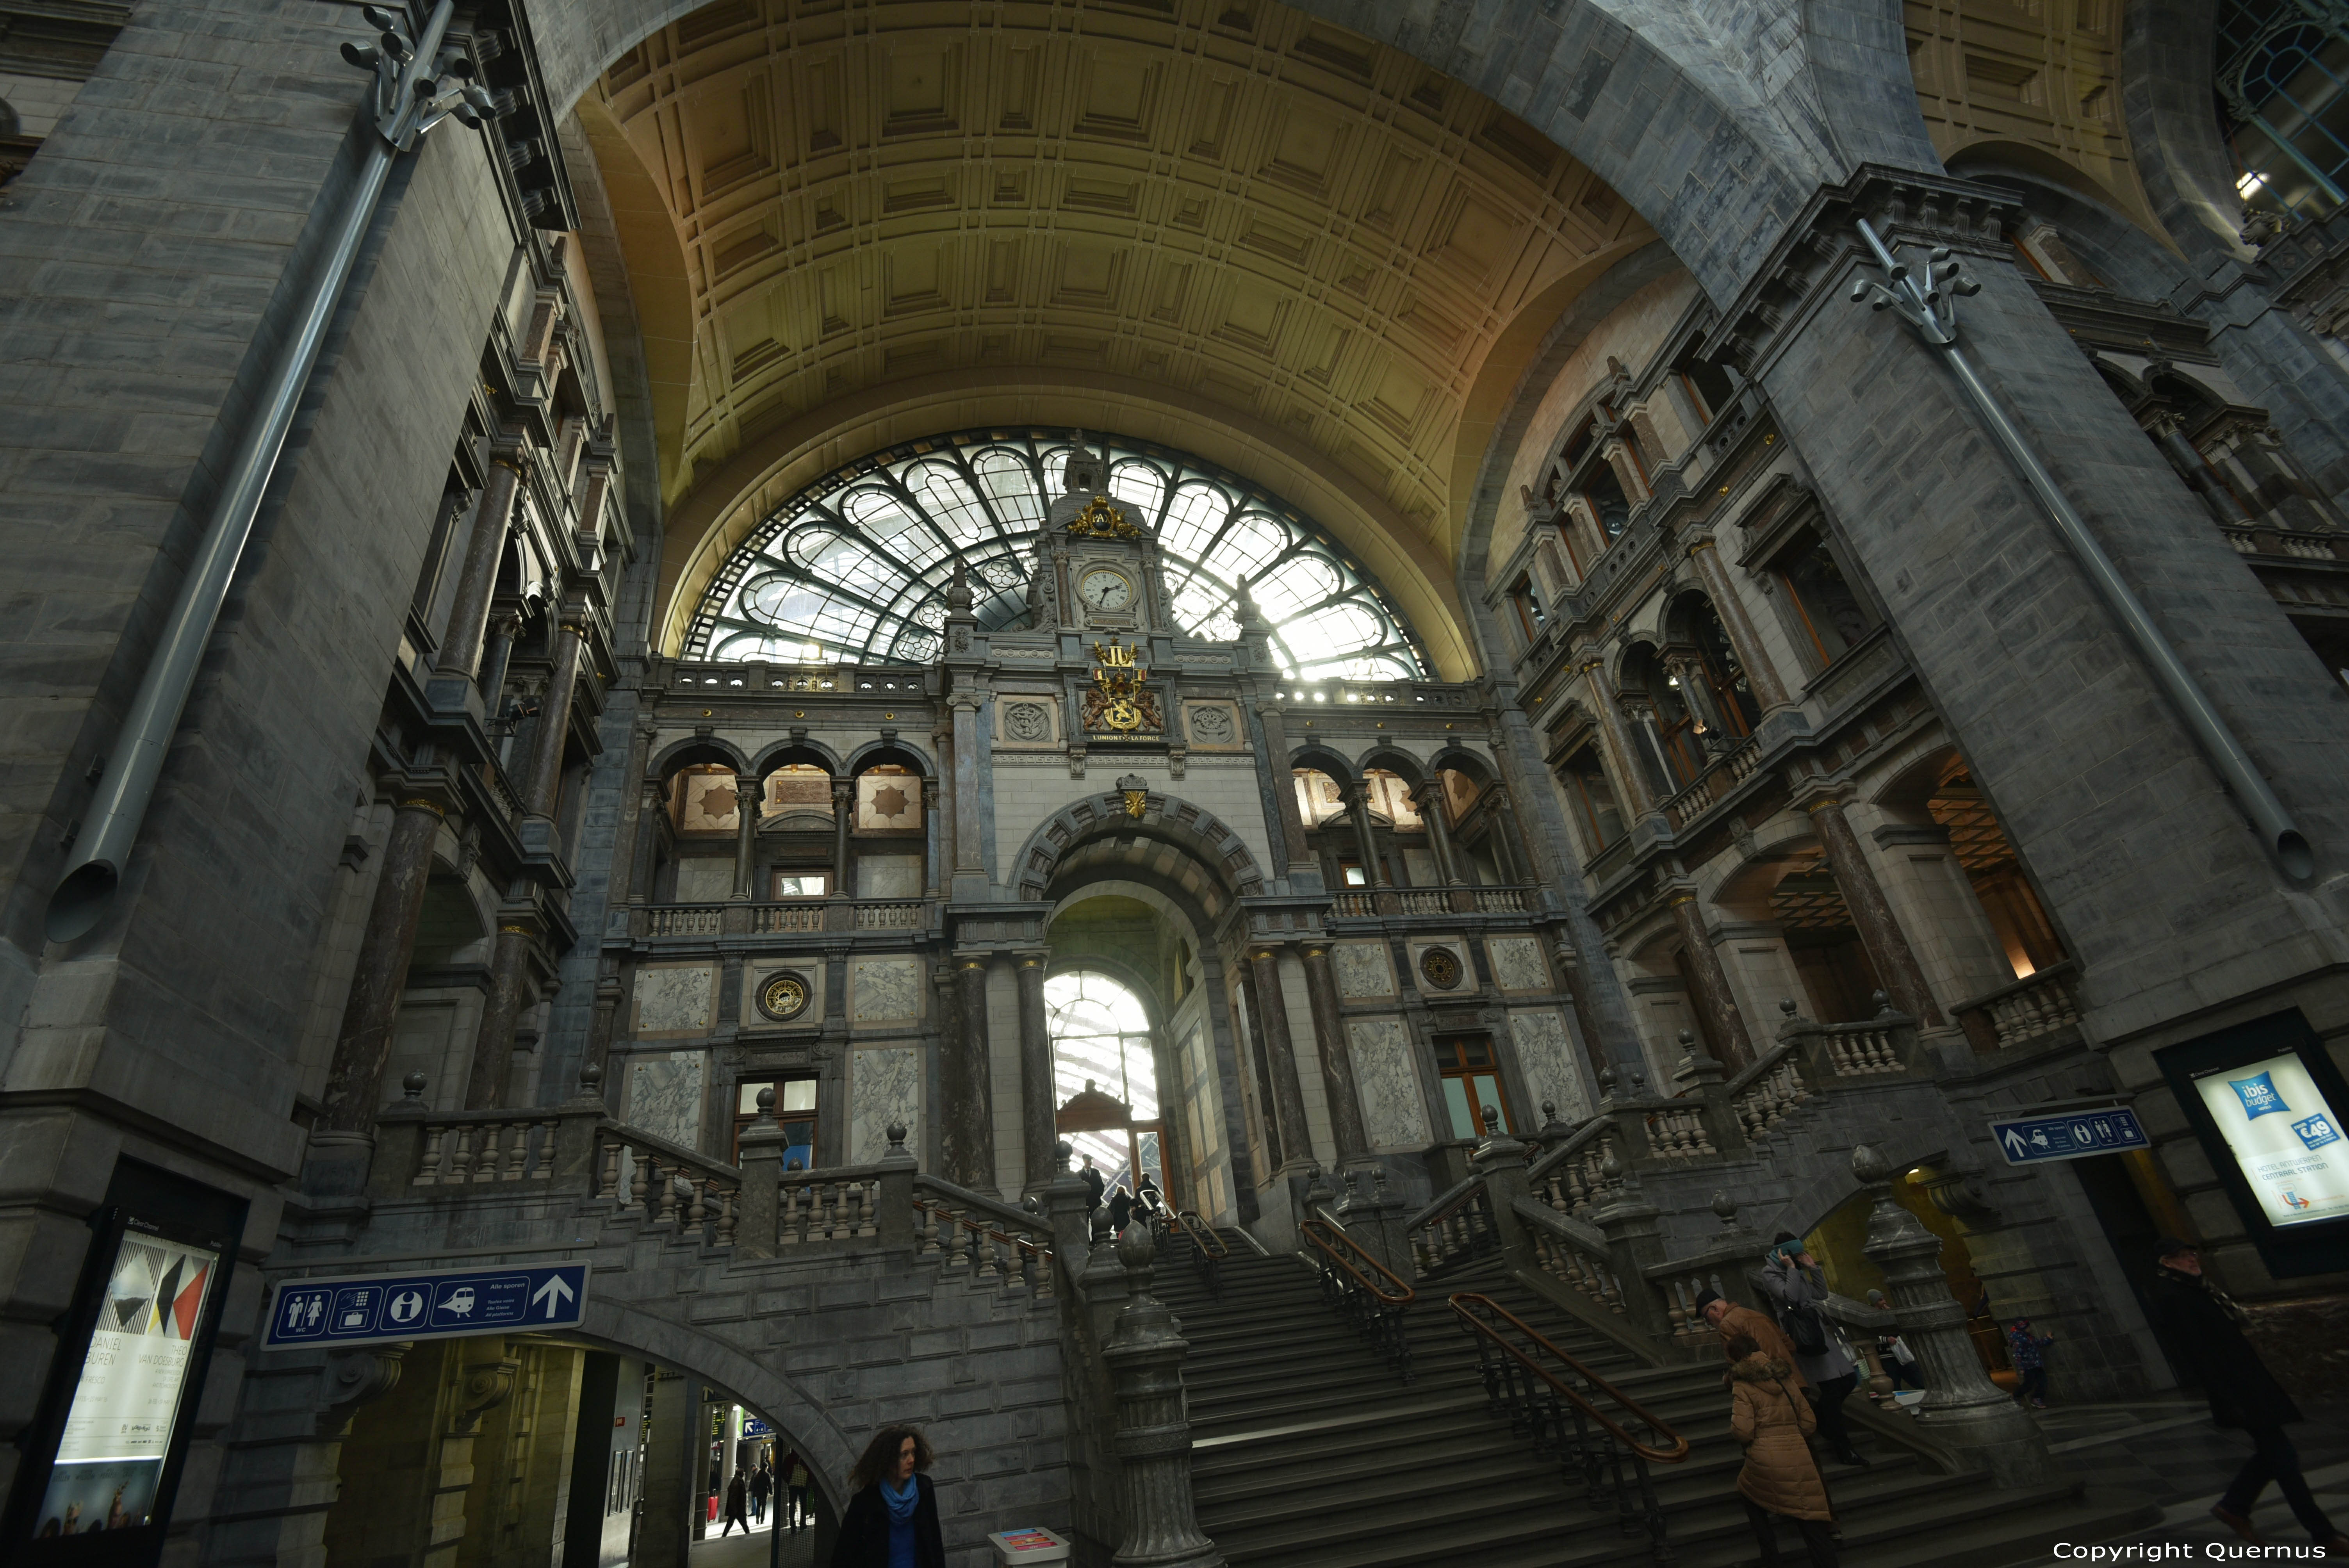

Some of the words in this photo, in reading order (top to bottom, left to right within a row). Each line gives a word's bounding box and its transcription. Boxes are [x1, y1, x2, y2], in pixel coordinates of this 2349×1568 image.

[1092, 513, 1110, 524] PAX
[2242, 1083, 2268, 1098] ibis
[2244, 1093, 2277, 1107] budget
[2300, 1121, 2331, 1138] €49
[2257, 1164, 2279, 1172] HOTEL
[2280, 1155, 2322, 1168] ANTWERPEN
[2262, 1169, 2297, 1181] CENTRAAL
[2297, 1162, 2329, 1174] STATION
[144, 1222, 160, 1231] Channel
[90, 1336, 121, 1350] DANIEL
[172, 1345, 187, 1355] THEO
[85, 1352, 116, 1365] BUREN
[139, 1354, 153, 1364] VAN
[153, 1355, 185, 1367] DOESBURG
[86, 1376, 105, 1384] FRESCO
